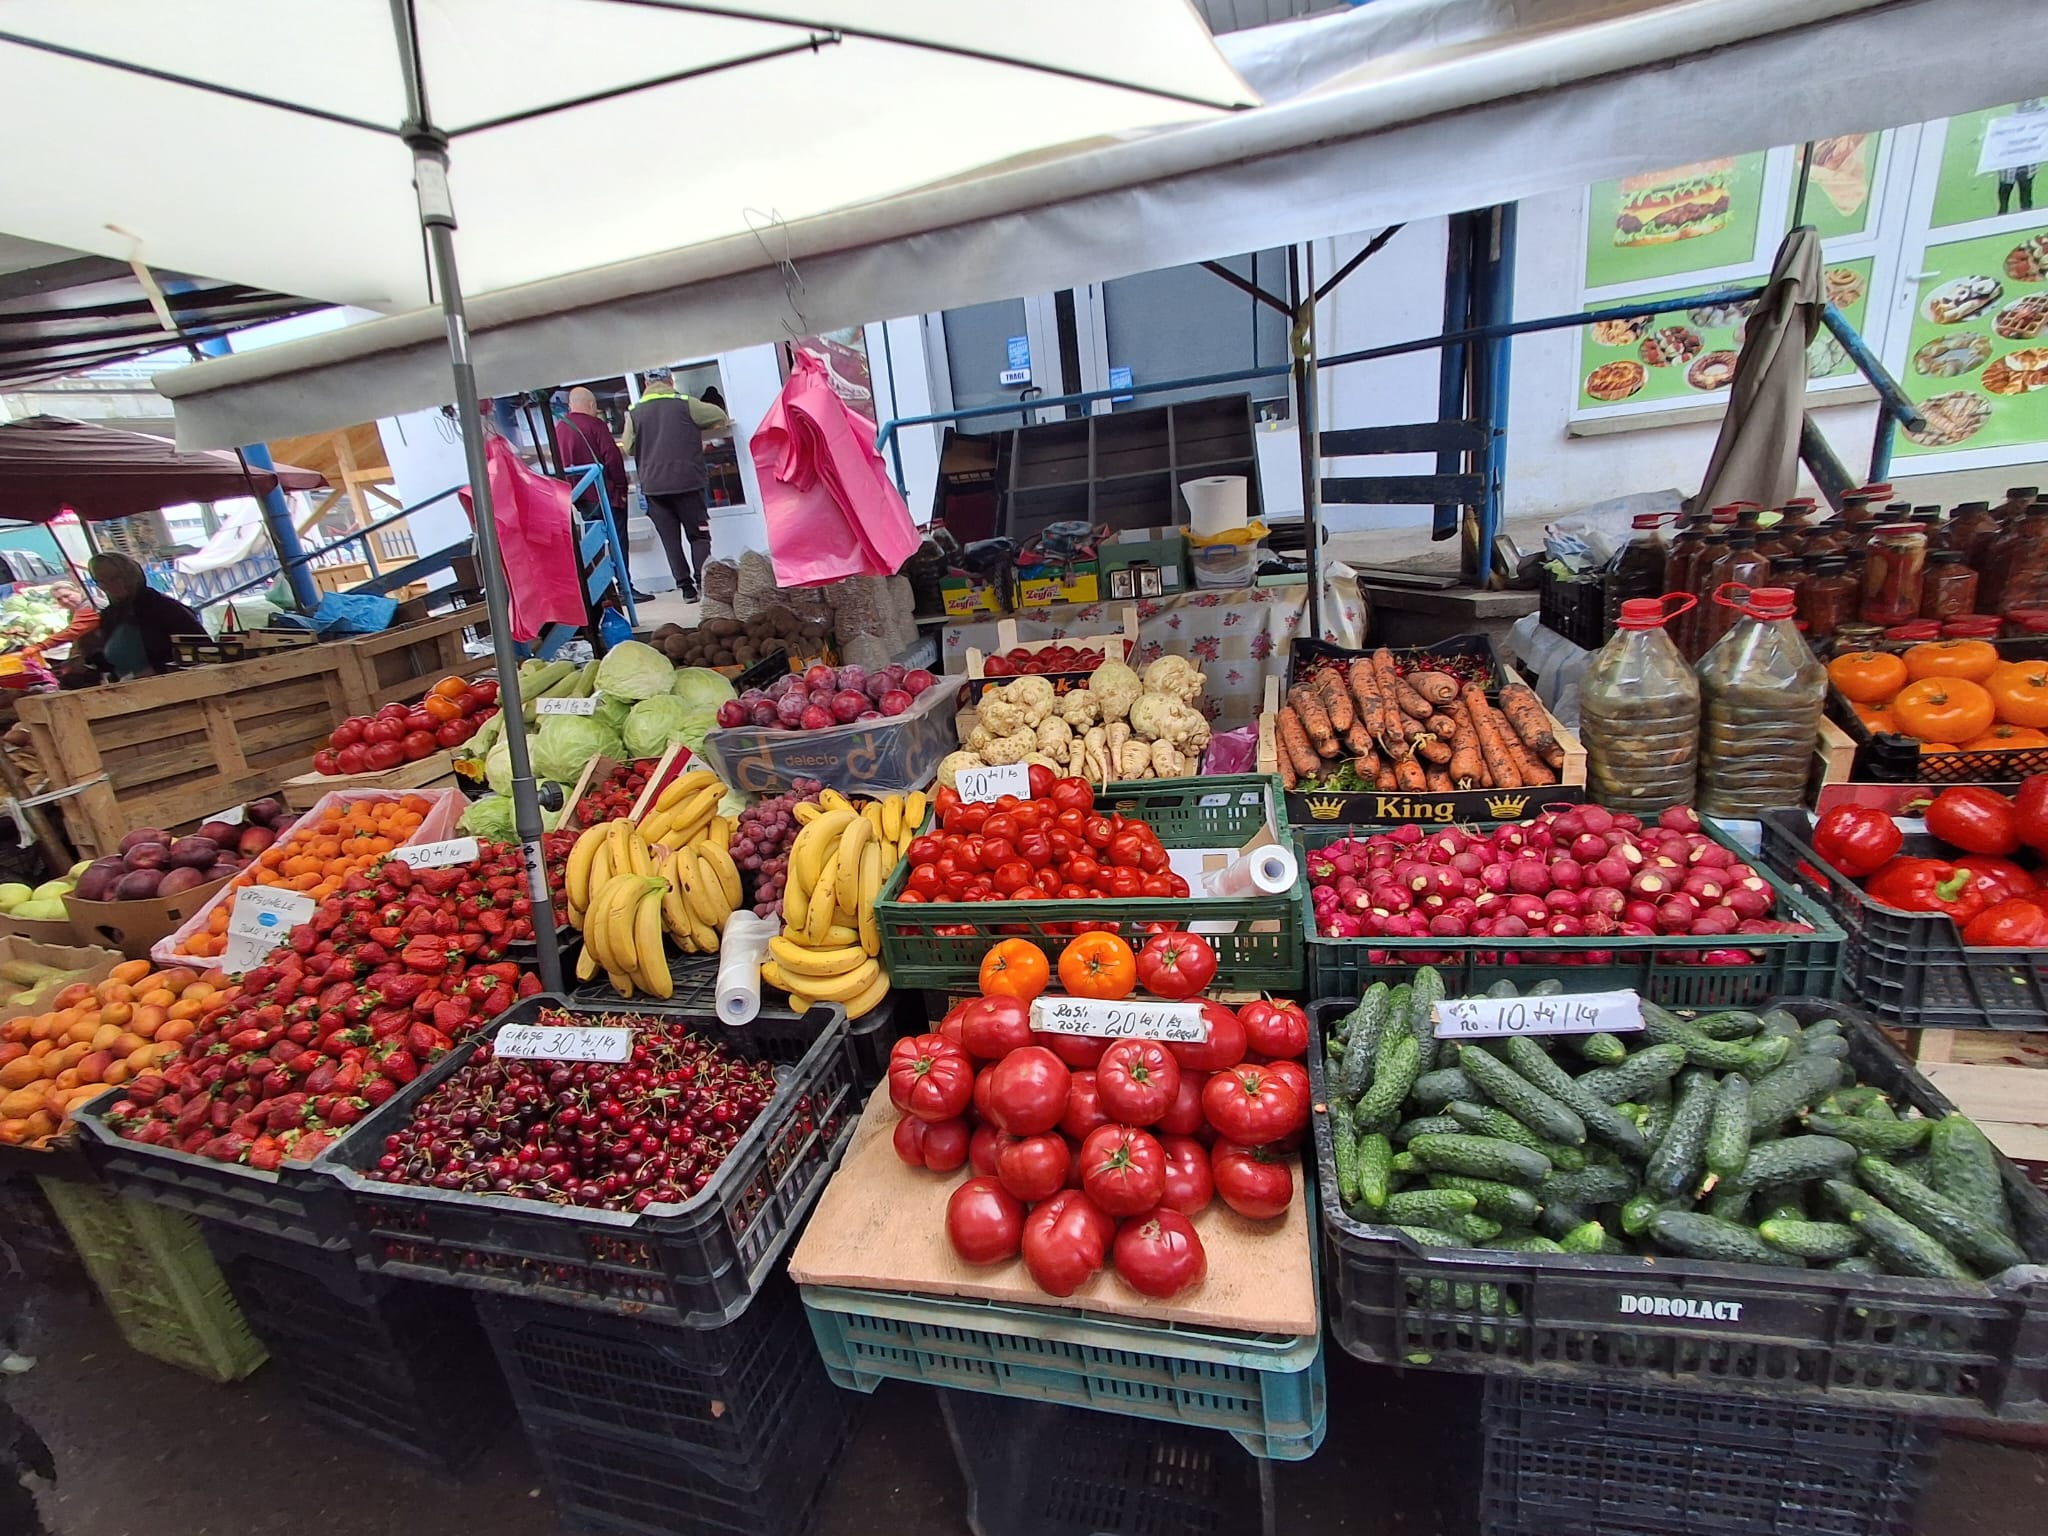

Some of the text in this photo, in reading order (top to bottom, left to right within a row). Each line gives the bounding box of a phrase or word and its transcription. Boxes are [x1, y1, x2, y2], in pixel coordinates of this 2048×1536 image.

[784, 754, 840, 767] delecta
[964, 773, 988, 798] 20
[1375, 796, 1456, 823] King
[408, 848, 431, 866] 30
[1104, 1010, 1136, 1036] 20
[1620, 1294, 1743, 1321] DOROLACT
